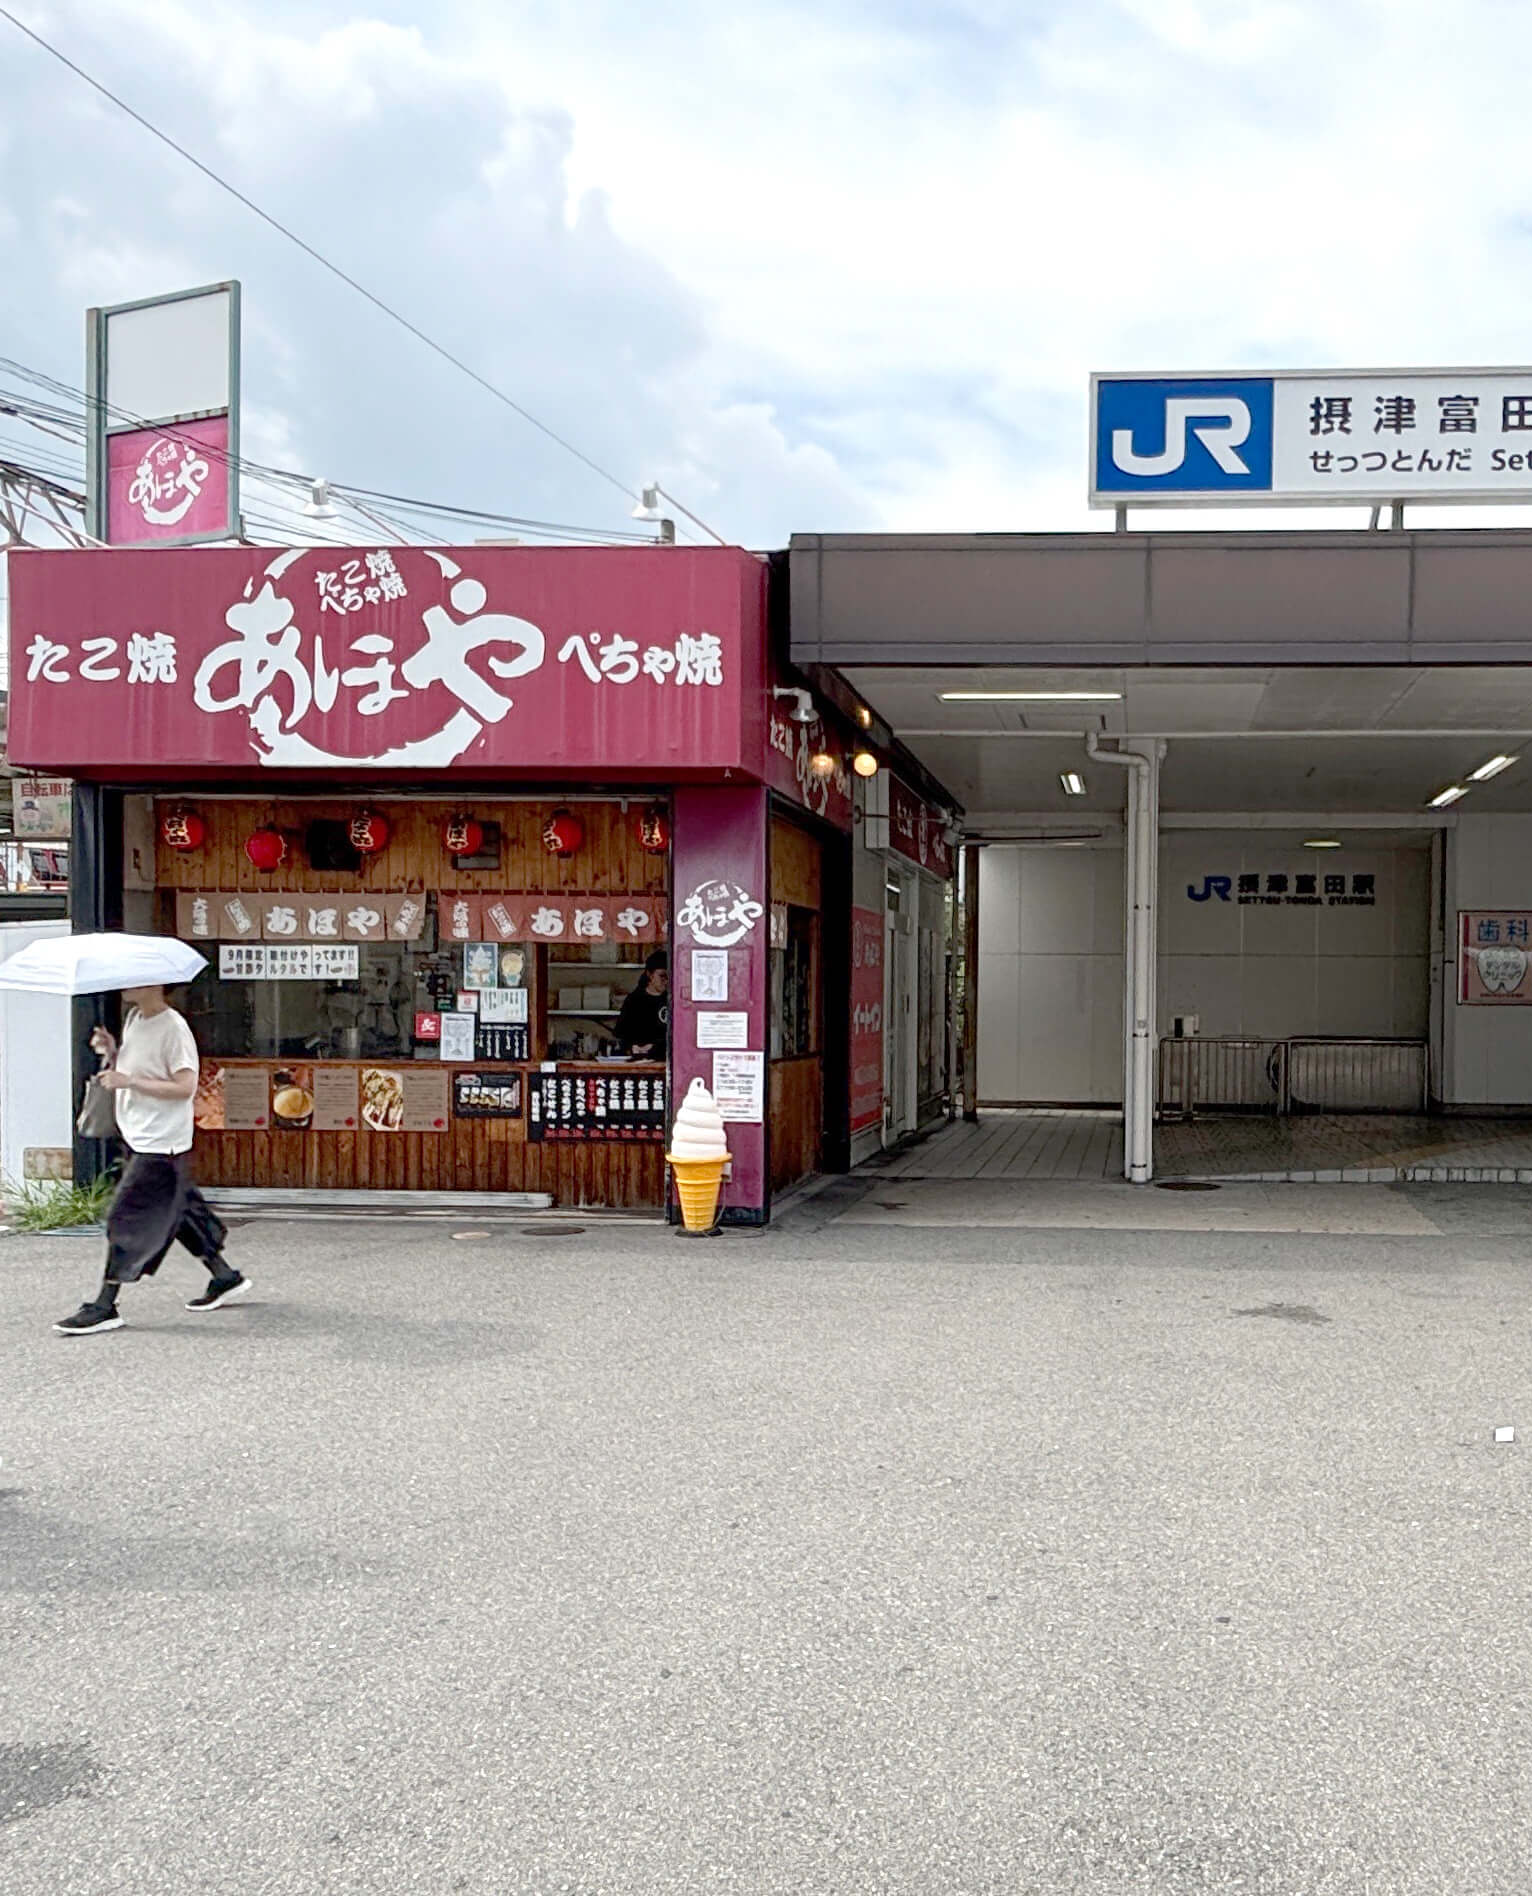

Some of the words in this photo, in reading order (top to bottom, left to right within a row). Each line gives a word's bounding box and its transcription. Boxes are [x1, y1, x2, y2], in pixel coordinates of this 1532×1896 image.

[1112, 398, 1252, 476] JR
[129, 448, 209, 504] あほや
[1310, 448, 1473, 473] せっつとんだ
[315, 549, 396, 596] たこ焼
[320, 572, 407, 615] ぺちゃ焼
[26, 632, 178, 684] たこ焼
[194, 579, 545, 728] あほや
[558, 632, 723, 686] ぺちゃ焼
[1187, 876, 1232, 902] JR
[266, 906, 380, 937] あほや
[530, 906, 649, 937] あほや
[677, 892, 764, 930] あほや
[1477, 919, 1529, 943] 歯科
